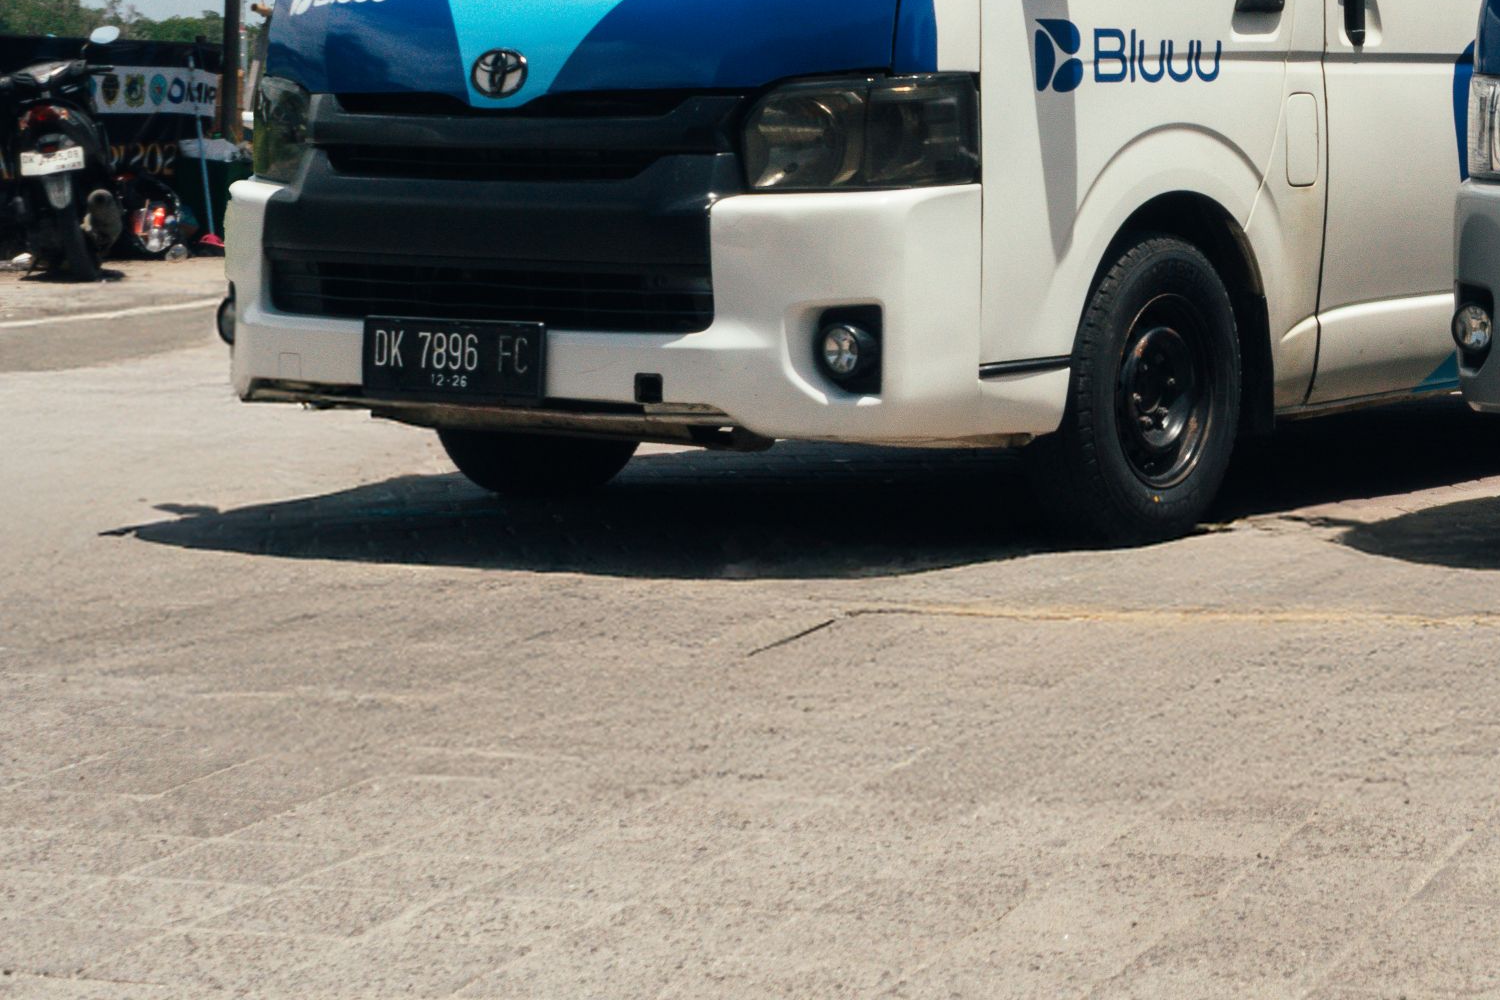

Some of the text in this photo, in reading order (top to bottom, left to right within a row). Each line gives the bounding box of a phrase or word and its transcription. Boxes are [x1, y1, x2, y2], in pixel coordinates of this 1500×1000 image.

[1093, 28, 1222, 83] Bluuu
[374, 329, 404, 367] DK
[418, 331, 479, 371] 7896
